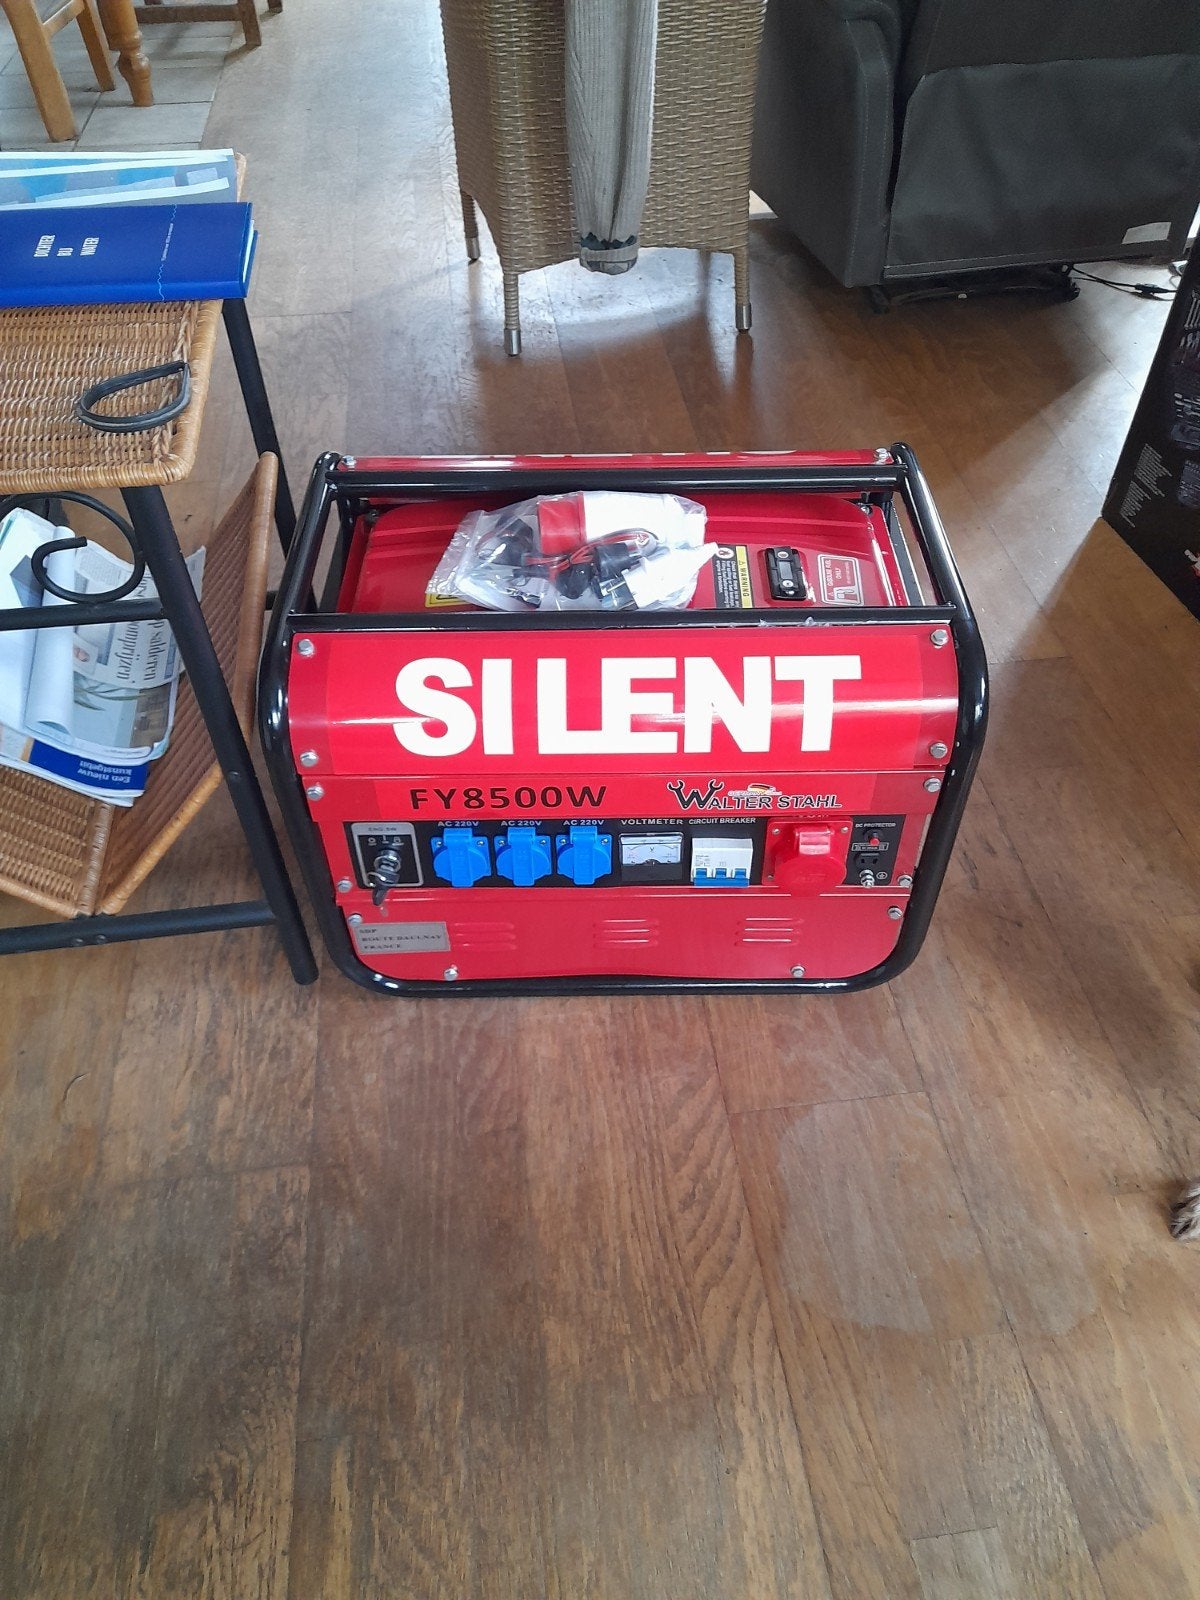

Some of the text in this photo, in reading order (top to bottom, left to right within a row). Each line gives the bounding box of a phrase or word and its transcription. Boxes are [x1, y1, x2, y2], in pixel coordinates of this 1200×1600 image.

[80, 237, 99, 257] WATER
[740, 568, 749, 597] WARNING
[143, 631, 168, 681] salderen
[392, 654, 861, 757] SILENT
[77, 768, 131, 784] Een nieuw
[410, 785, 607, 809] FY8500W
[667, 779, 843, 810] WALTER STAHL
[621, 818, 683, 826] VOLTMETER
[720, 817, 756, 825] BREAKER
